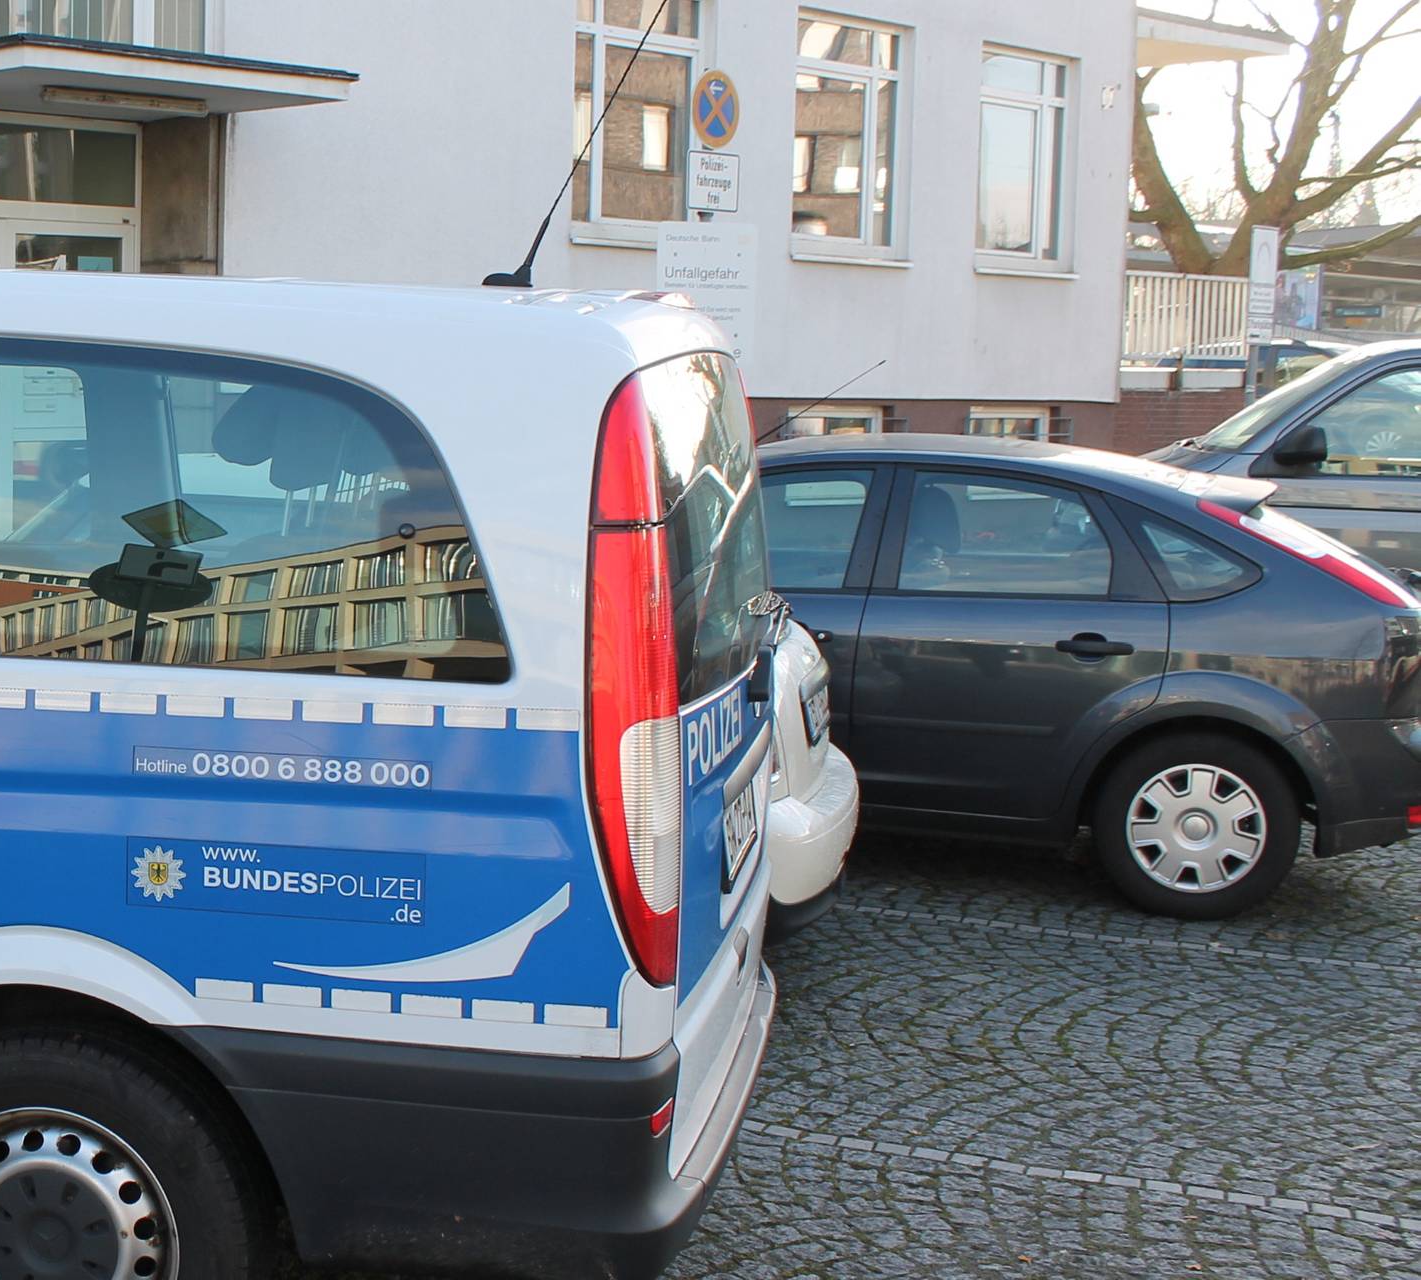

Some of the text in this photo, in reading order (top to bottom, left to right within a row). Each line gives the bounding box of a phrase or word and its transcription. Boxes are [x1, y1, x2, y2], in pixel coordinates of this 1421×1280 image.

[700, 156, 729, 171] Polizei-
[695, 173, 732, 192] fahrzeuge
[707, 190, 721, 205] frei
[664, 265, 741, 281] Unfallgefahr
[687, 685, 742, 786] POLIZEI
[135, 752, 430, 788] Hotline 0800 6 888 000
[201, 846, 261, 863] www.
[203, 866, 422, 901] BUNDESPOLIZEI
[389, 904, 423, 924] .de
